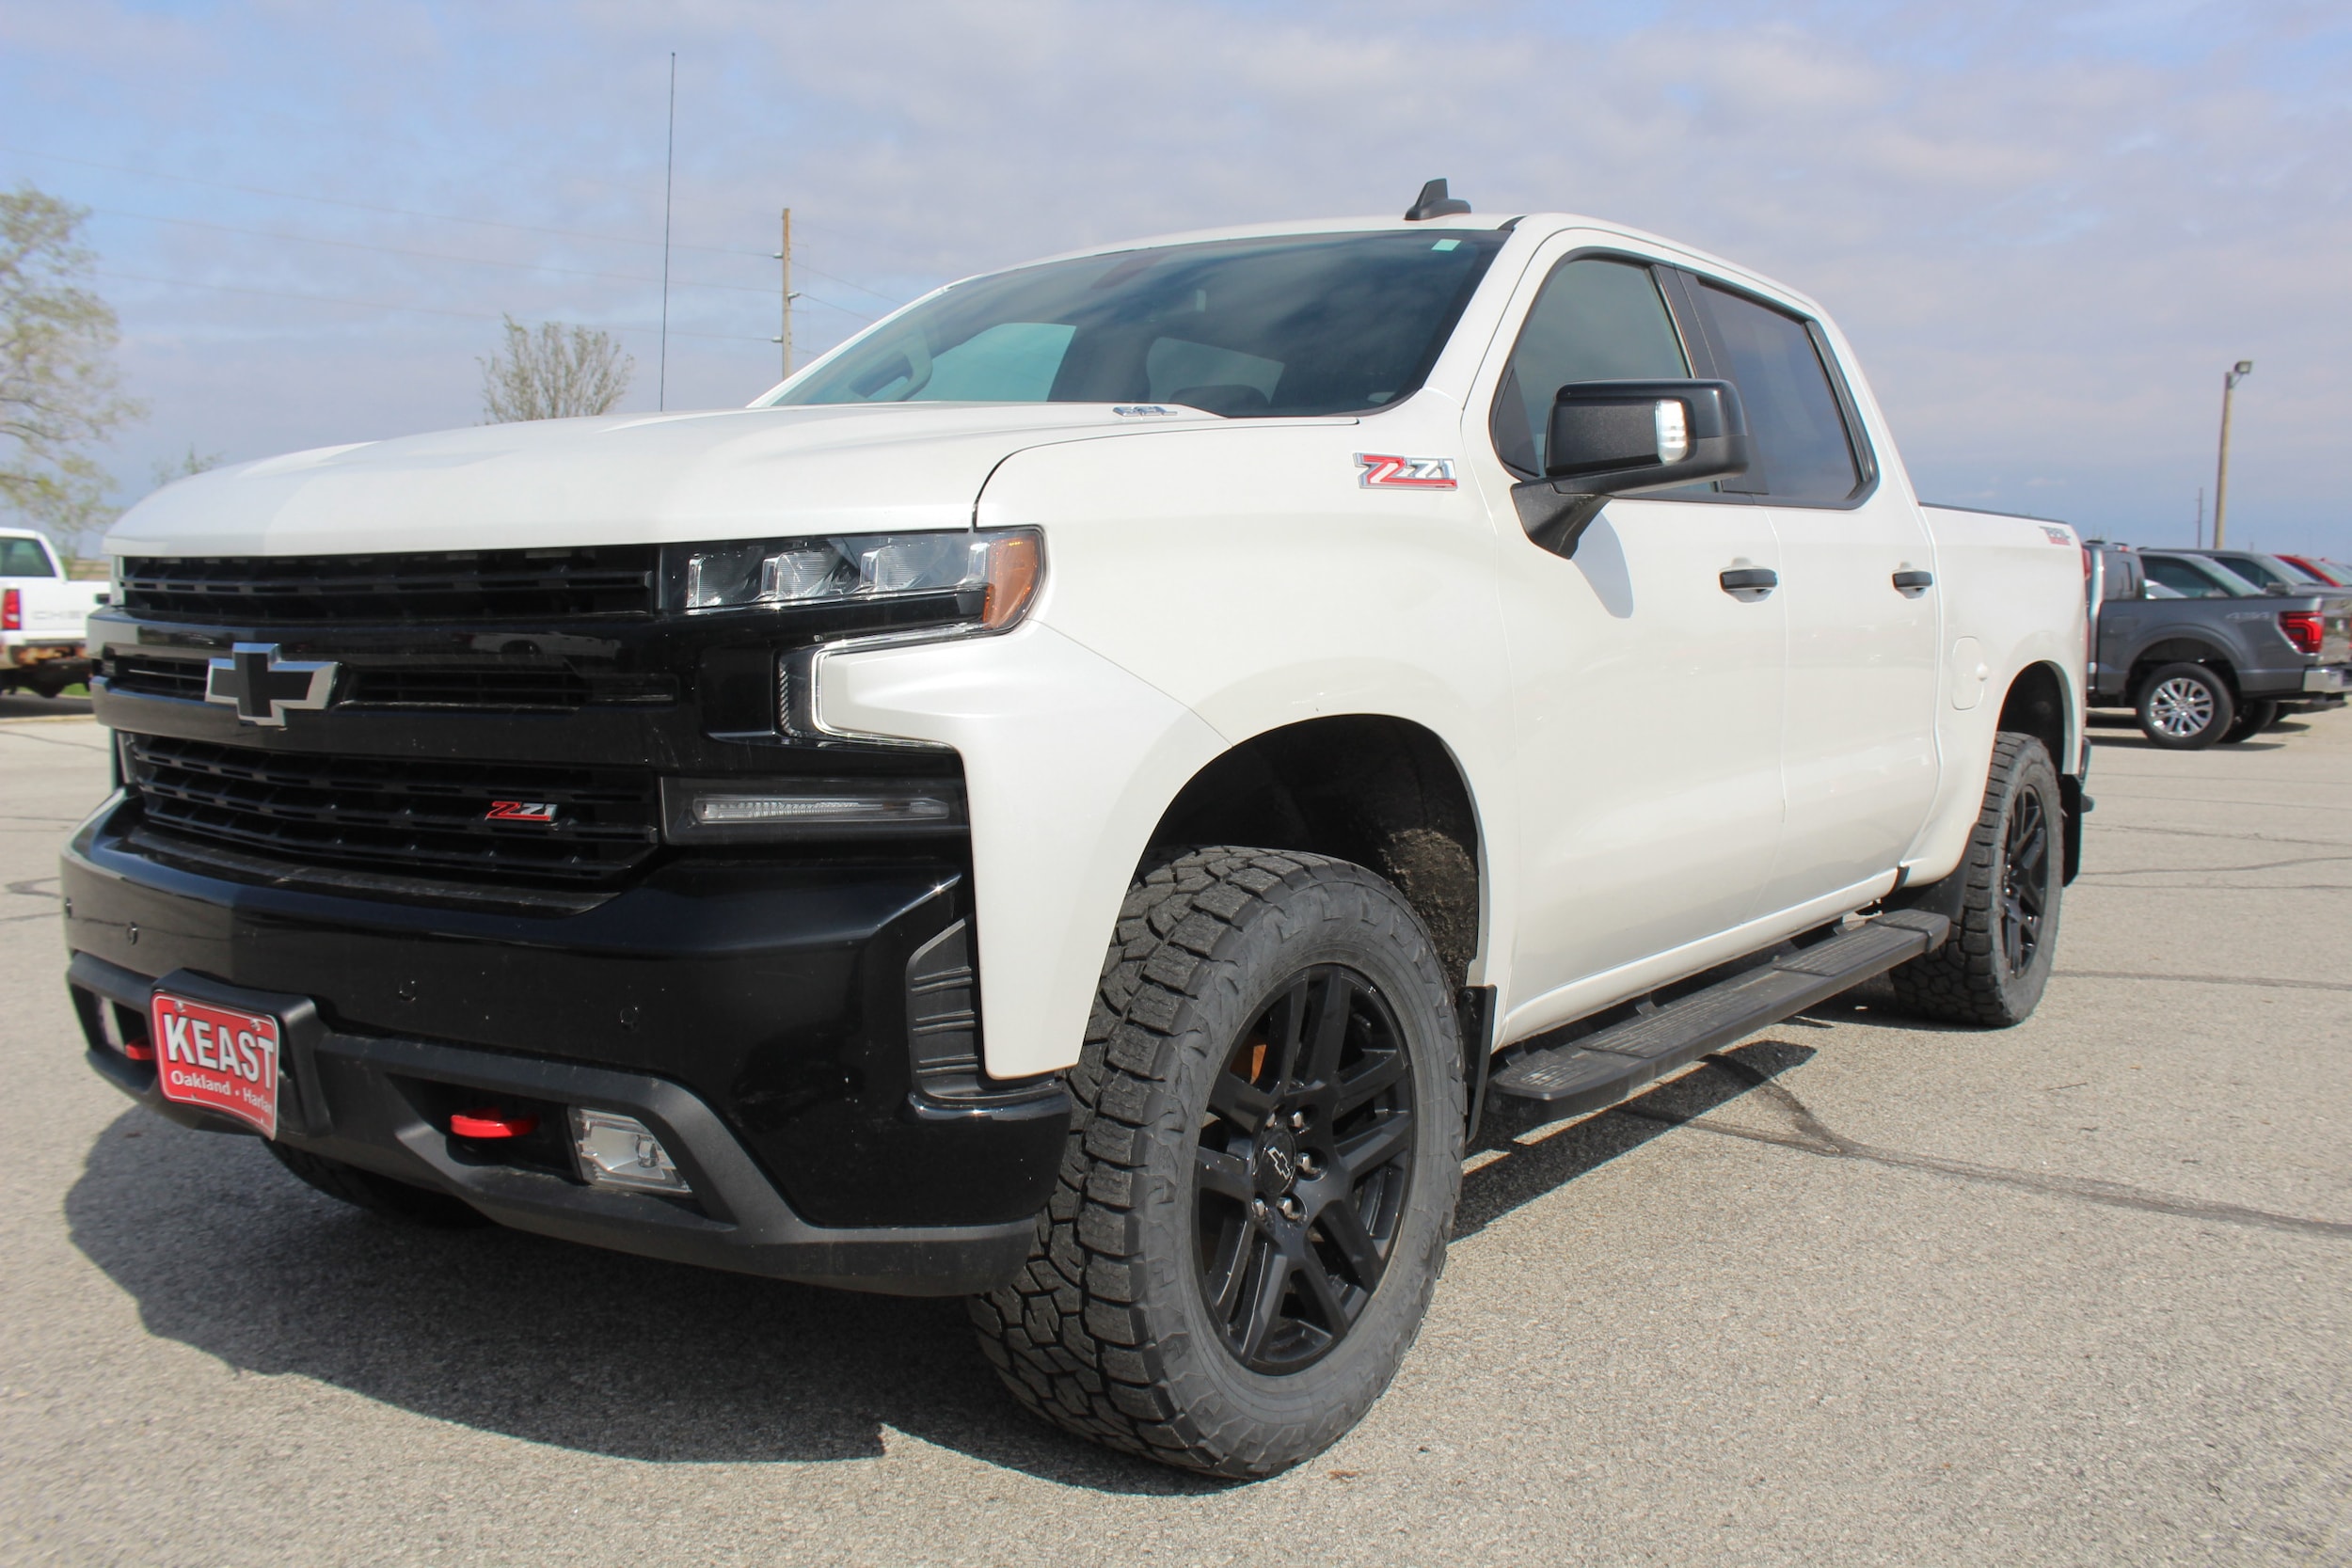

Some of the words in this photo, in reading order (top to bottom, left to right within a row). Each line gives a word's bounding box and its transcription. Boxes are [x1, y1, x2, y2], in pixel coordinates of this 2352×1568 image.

[1353, 452, 1458, 491] Z71
[485, 800, 557, 822] Z71
[164, 1014, 274, 1089] KEAST
[170, 1070, 231, 1095] Oakland
